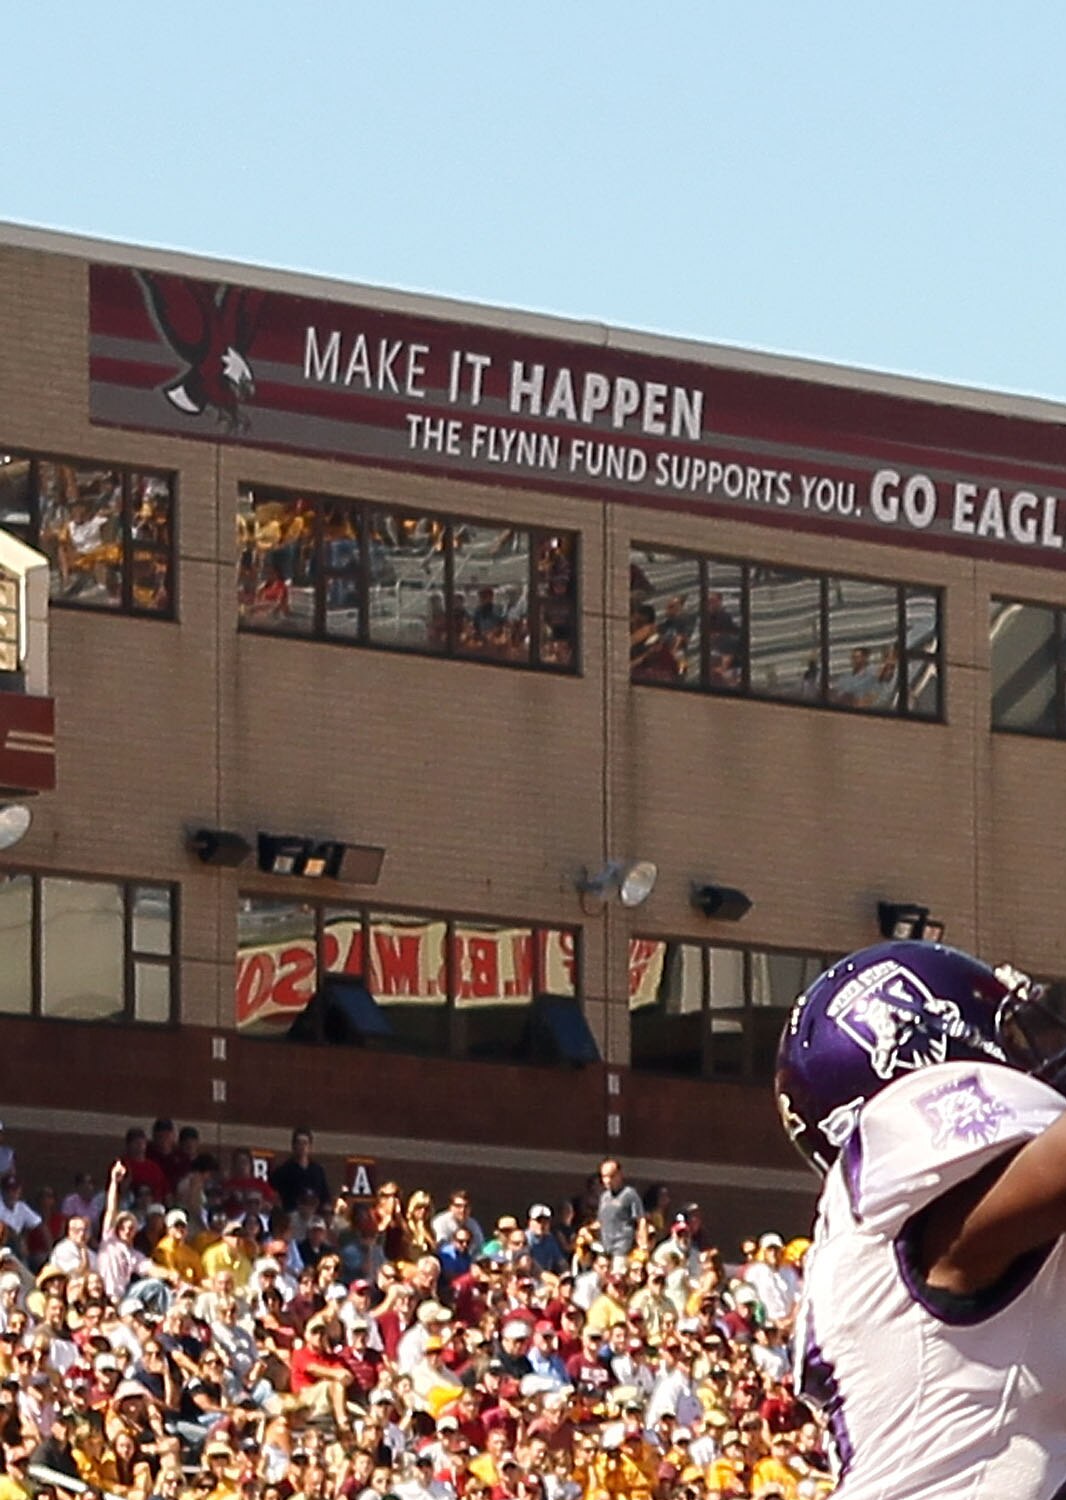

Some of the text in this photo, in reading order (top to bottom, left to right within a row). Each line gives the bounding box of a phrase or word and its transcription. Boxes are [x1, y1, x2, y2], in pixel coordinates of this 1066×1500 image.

[303, 327, 705, 440] MAKE IT HAPPEN
[406, 414, 461, 454] THE
[471, 425, 559, 470] FLYNN
[570, 439, 647, 482] FUND
[655, 452, 791, 507] SUPPORTS
[801, 475, 862, 517] YOU.
[870, 469, 936, 529] GO
[352, 1165, 372, 1194] A
